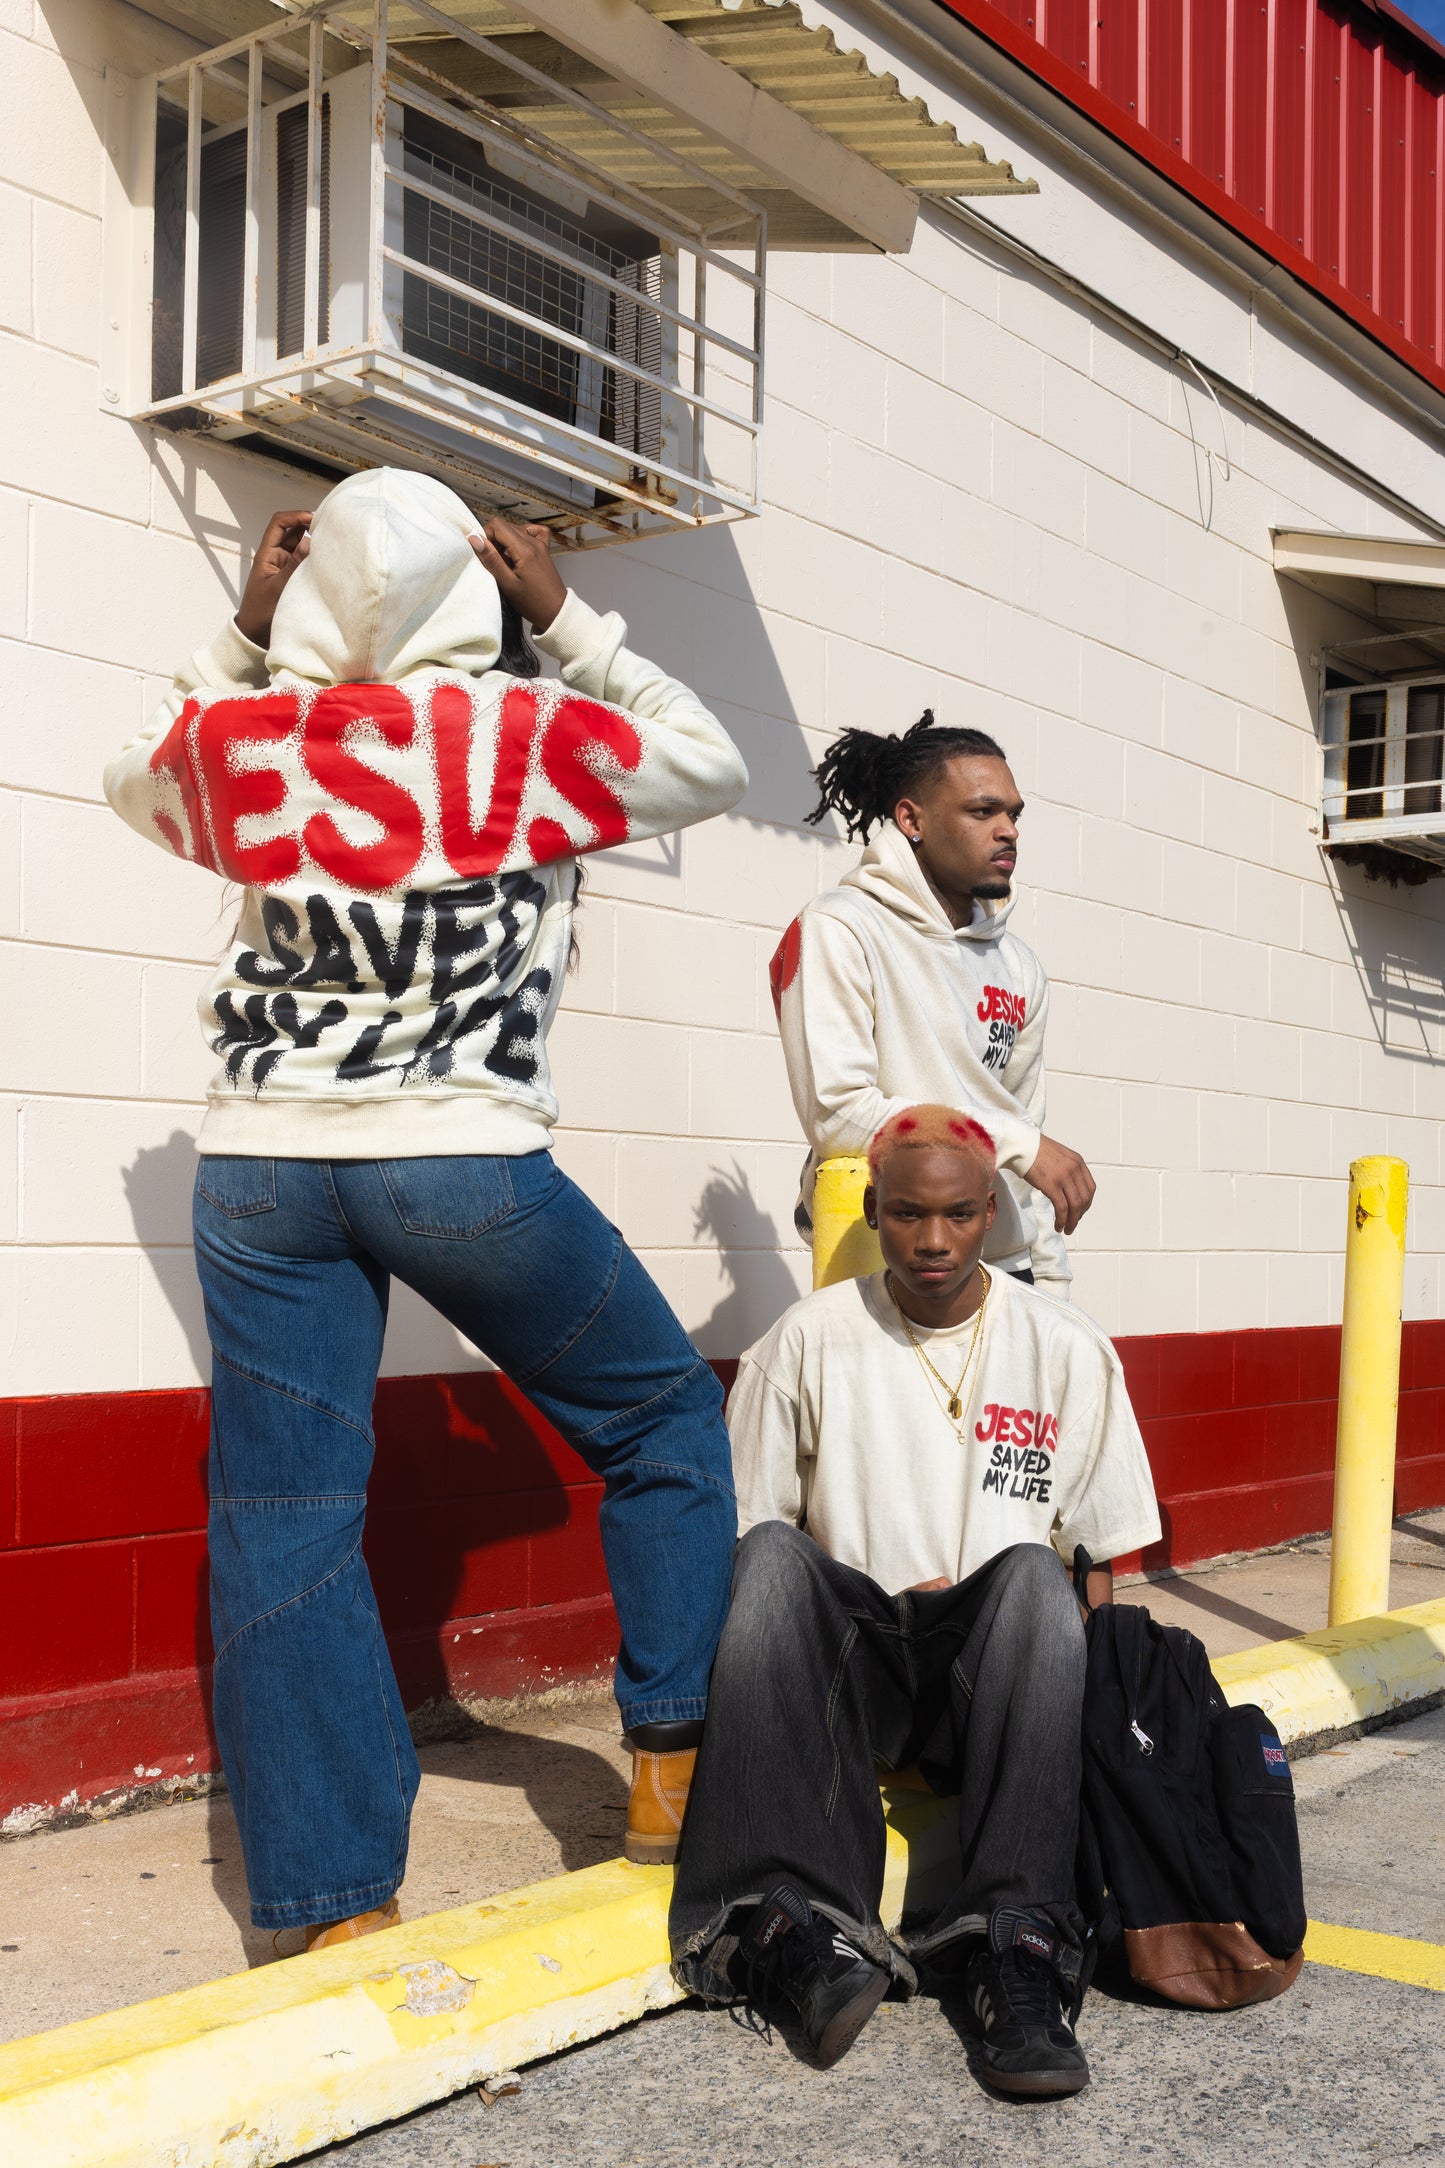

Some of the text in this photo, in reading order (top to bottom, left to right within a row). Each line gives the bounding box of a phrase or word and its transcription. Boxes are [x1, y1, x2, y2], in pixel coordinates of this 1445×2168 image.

[148, 677, 643, 894] JESUS
[234, 869, 548, 1003] SAVED
[977, 985, 1025, 1031] JESUS
[211, 967, 554, 1095] MY LIFE
[982, 1046, 1002, 1069] MY
[974, 1403, 1059, 1453] JESUS
[990, 1444, 1051, 1475] SAVED
[982, 1468, 1053, 1503] MY LIFE
[763, 1914, 783, 1944] adidas
[1021, 1933, 1050, 1952] adidas
